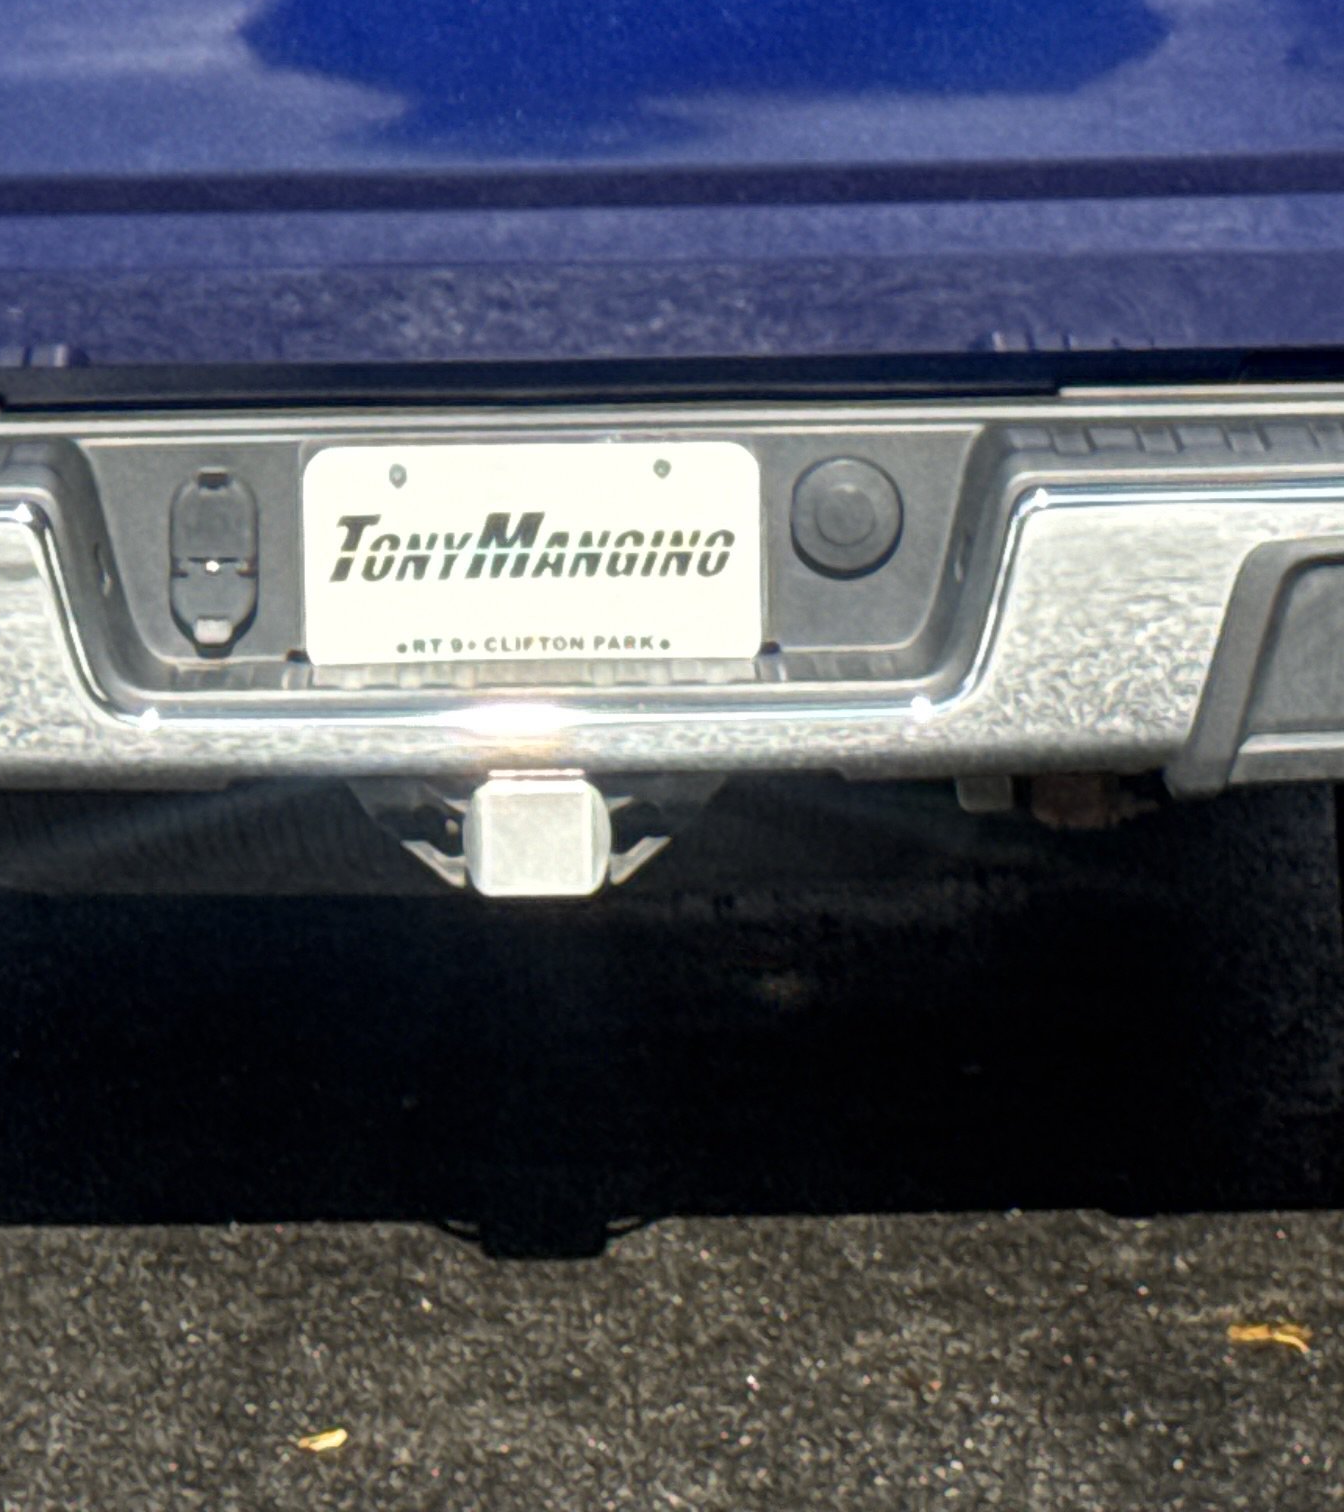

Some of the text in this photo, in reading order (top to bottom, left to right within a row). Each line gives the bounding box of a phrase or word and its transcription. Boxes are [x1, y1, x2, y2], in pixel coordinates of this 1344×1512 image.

[412, 638, 443, 654] RT
[483, 635, 585, 652] CLIFTON
[593, 634, 654, 650] PARK
